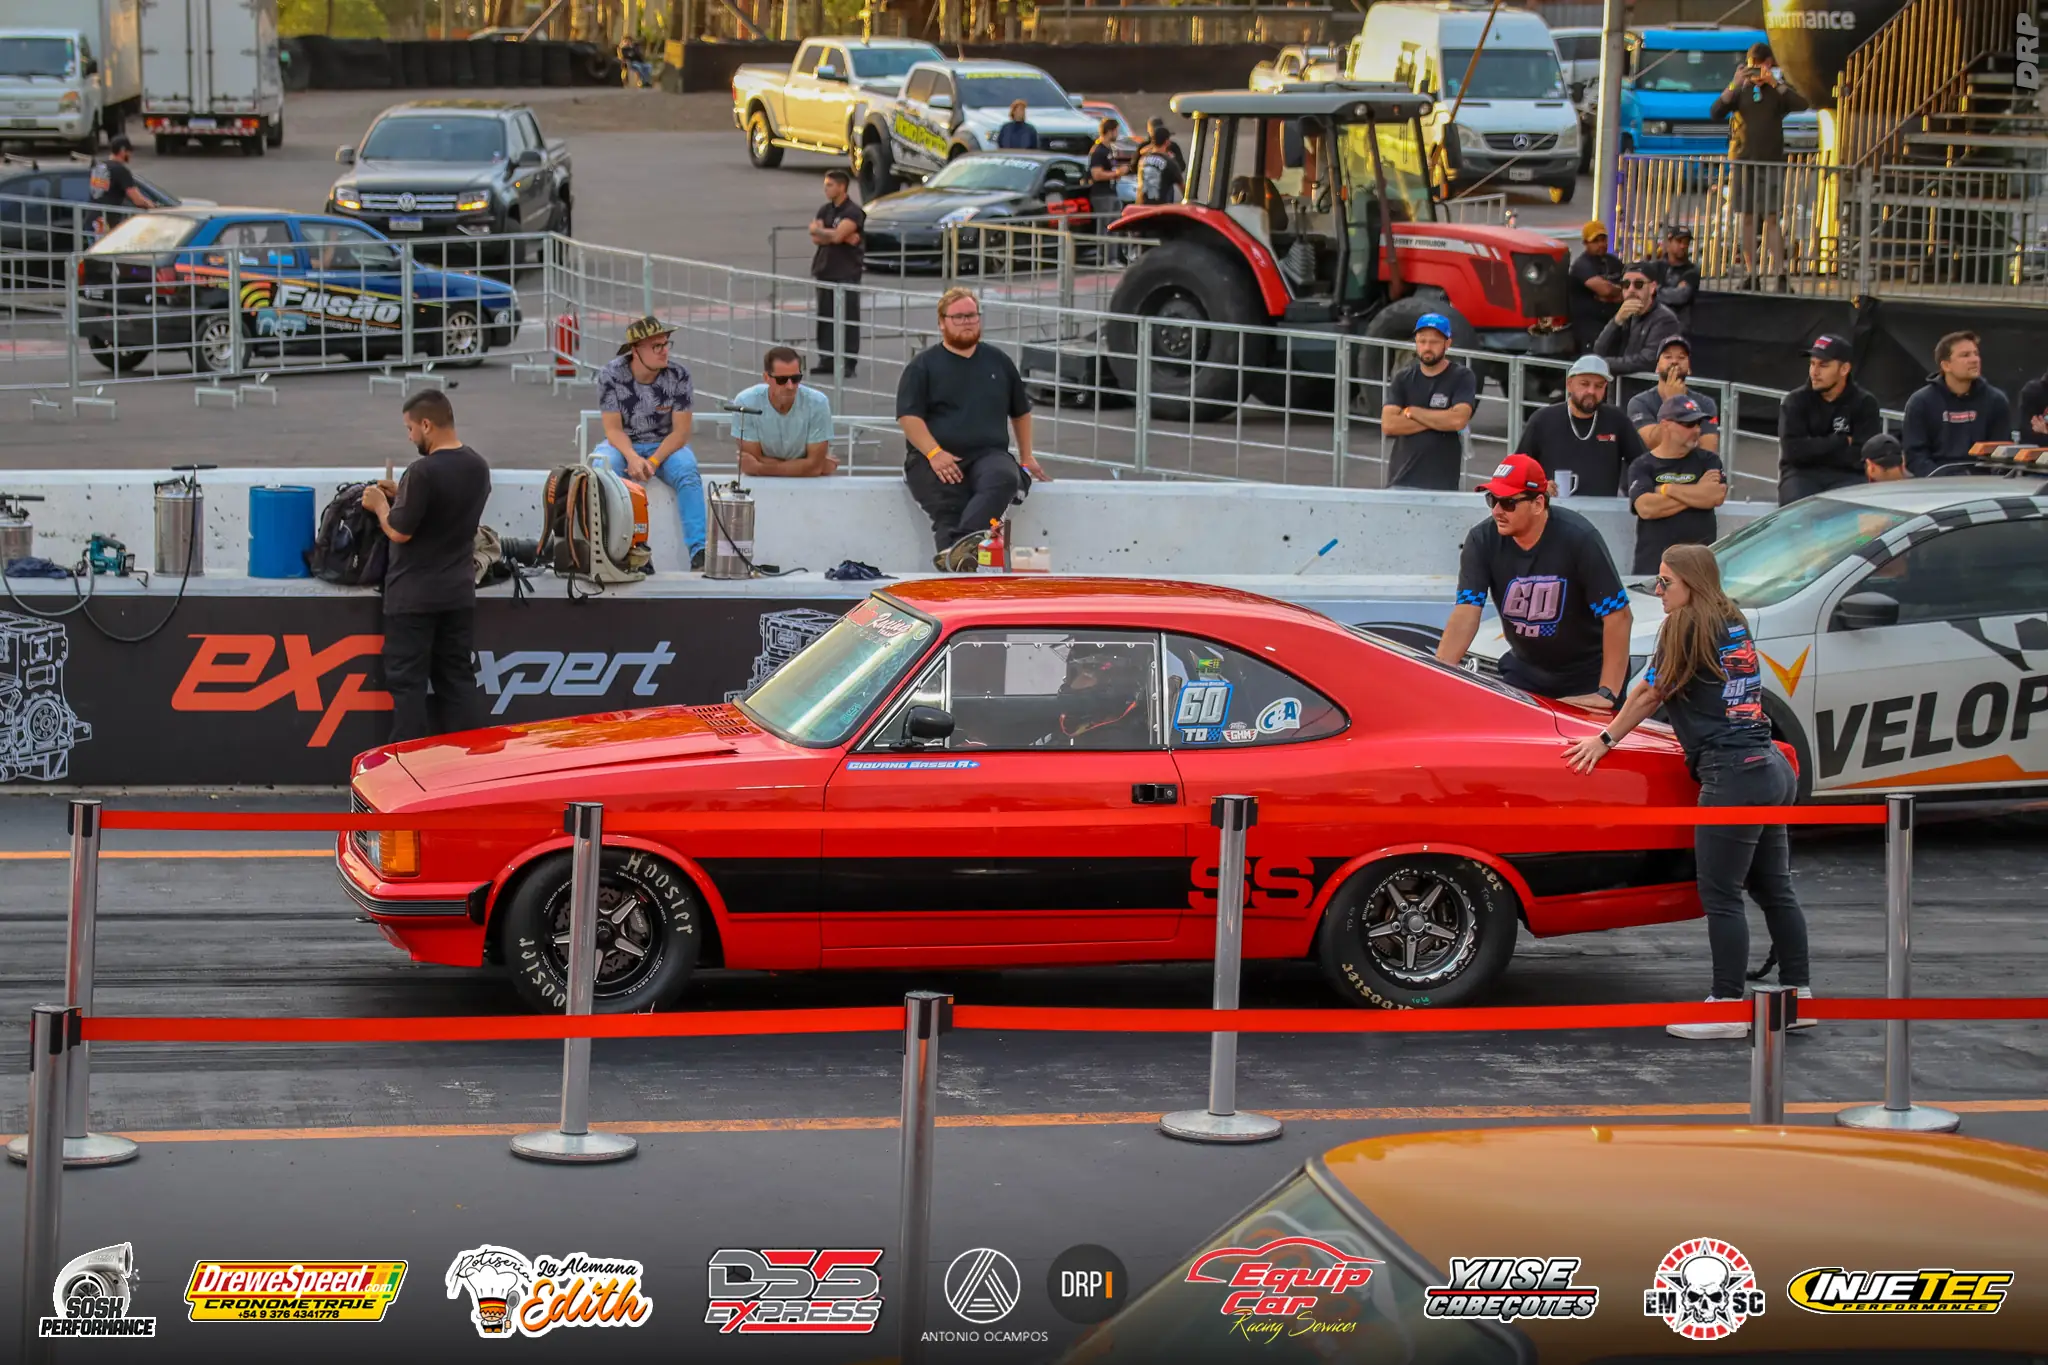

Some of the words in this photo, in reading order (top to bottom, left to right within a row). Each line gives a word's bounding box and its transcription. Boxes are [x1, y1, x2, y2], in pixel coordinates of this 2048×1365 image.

[273, 282, 401, 324] Fusão
[1502, 580, 1561, 621] 60
[468, 640, 677, 715] xpert
[1176, 686, 1229, 724] 60
[1263, 701, 1297, 729] CBA
[1187, 855, 1315, 911] SS
[518, 936, 568, 1008] oosier
